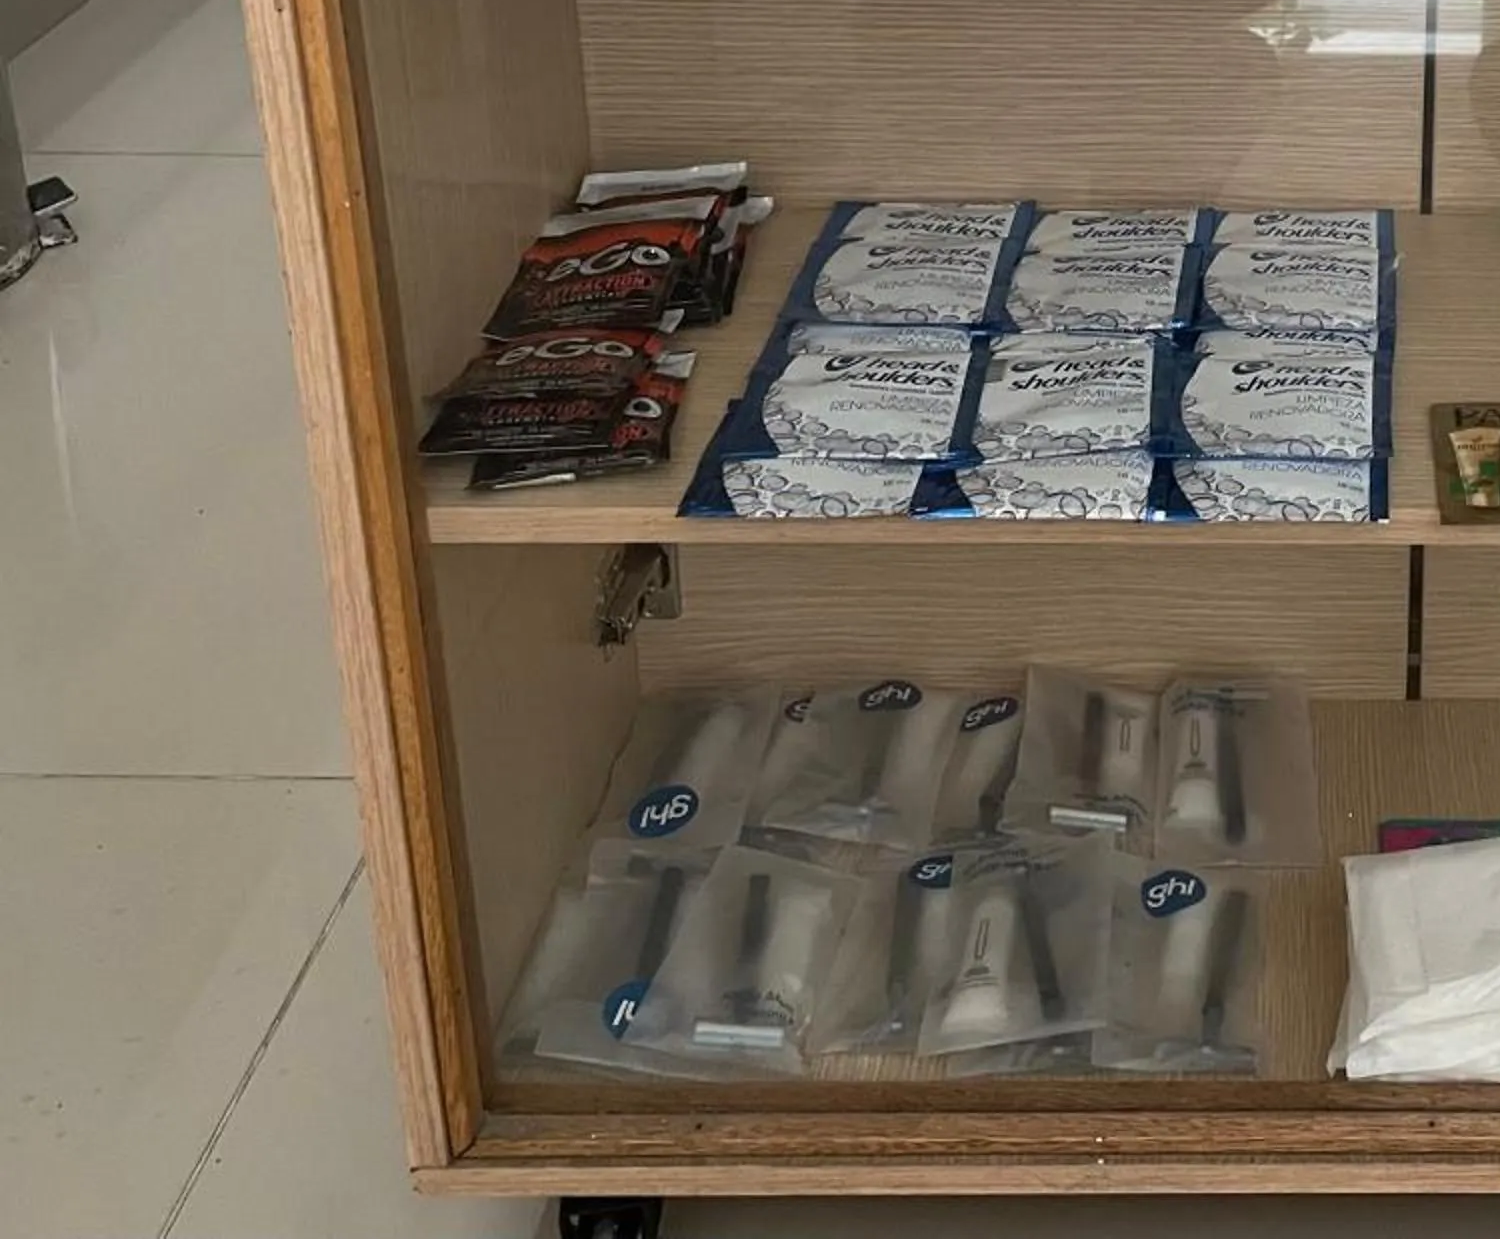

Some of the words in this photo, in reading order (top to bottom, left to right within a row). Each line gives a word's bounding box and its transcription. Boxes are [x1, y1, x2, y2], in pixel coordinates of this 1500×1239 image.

[1255, 225, 1370, 241] shoulders
[1250, 261, 1371, 277] shoulders
[867, 358, 946, 373] head
[1053, 356, 1131, 373] head
[1275, 365, 1352, 375] head
[1008, 367, 1145, 391] shoulders
[1233, 374, 1366, 393] shoulders
[863, 682, 911, 710] ghl
[963, 698, 1009, 728] ghl
[640, 794, 692, 828] ghl
[1146, 875, 1196, 909] ghl
